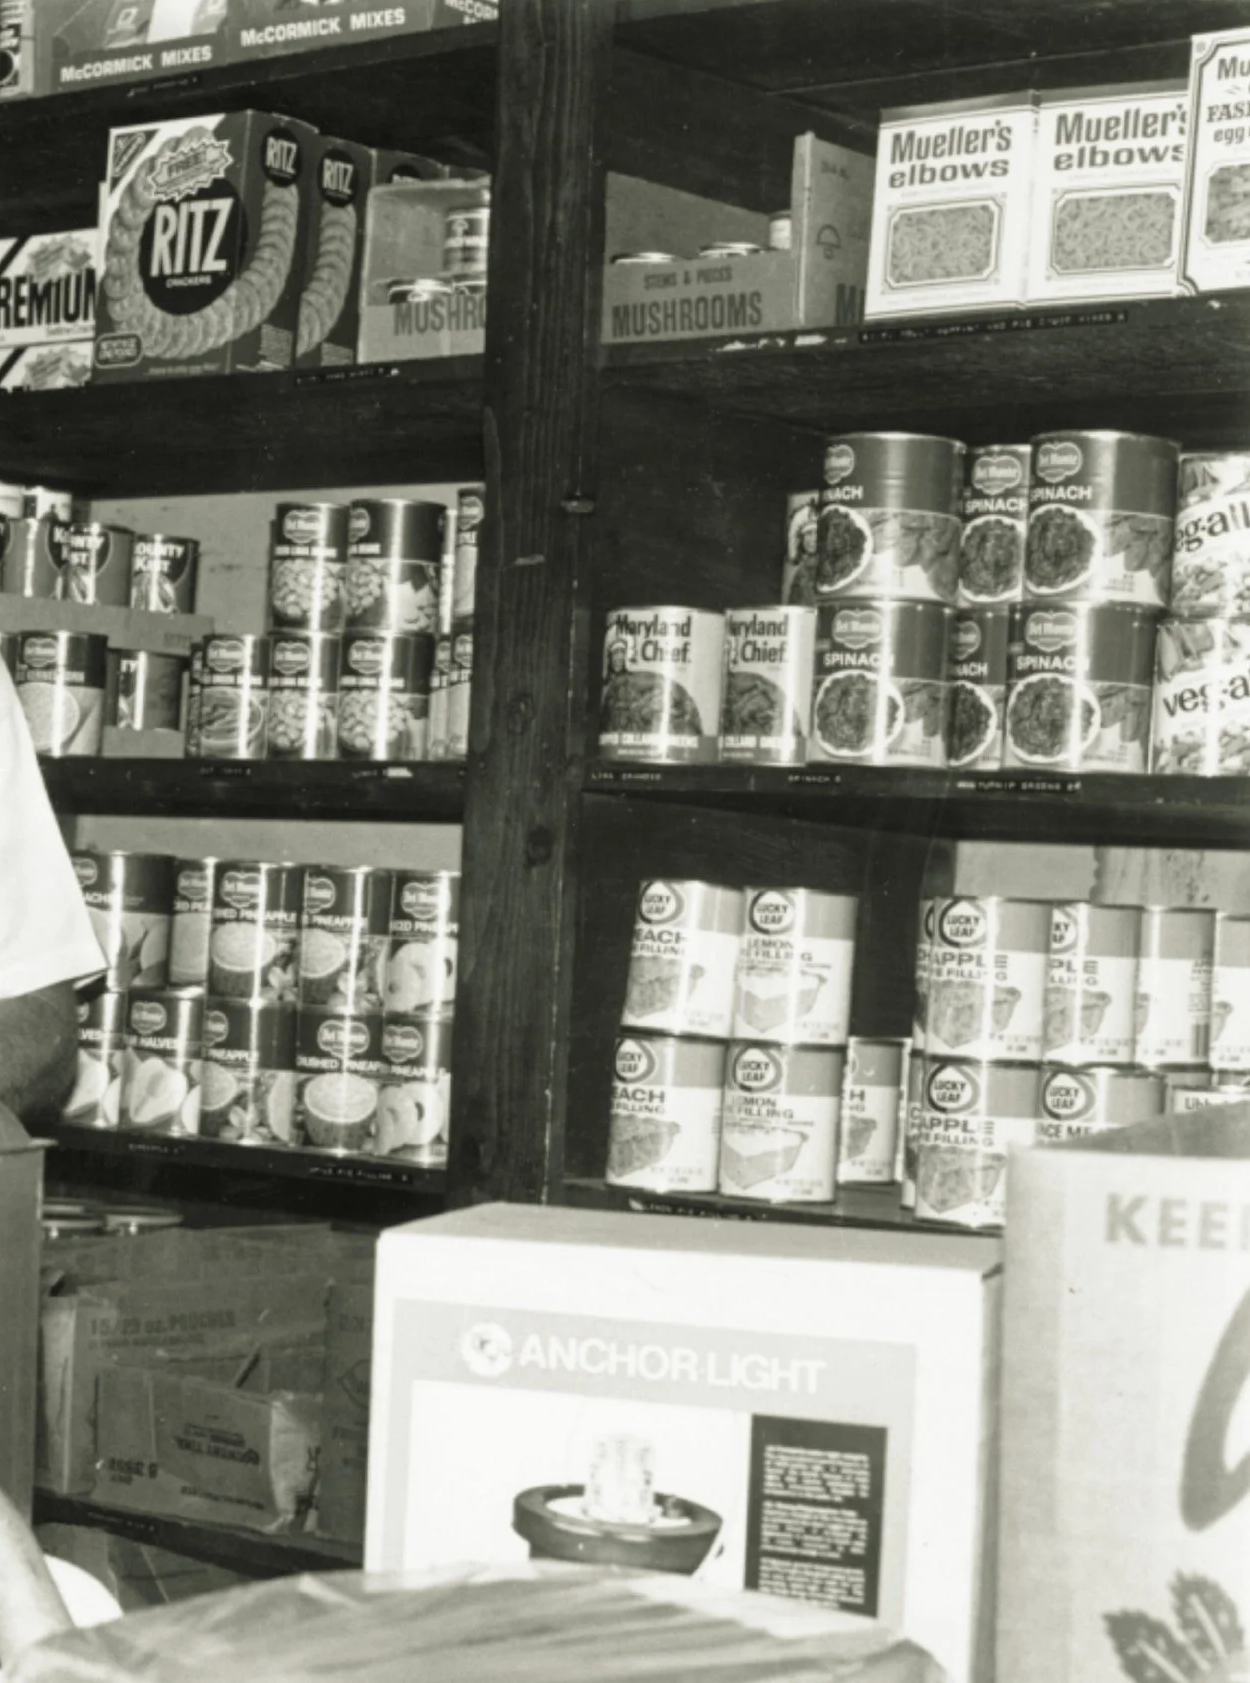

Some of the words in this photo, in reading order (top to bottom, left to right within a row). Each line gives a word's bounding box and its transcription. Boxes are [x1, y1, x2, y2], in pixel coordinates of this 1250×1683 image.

[241, 16, 341, 46] McCORMICK
[350, 7, 406, 31] MIXES
[60, 54, 153, 83] McCORMICK
[161, 45, 212, 67] MIXES
[890, 119, 1012, 165] Mueller's
[1213, 125, 1245, 146] egg
[266, 135, 298, 174] RITZ
[322, 158, 354, 196] RITZ
[888, 158, 1010, 189] elbows
[149, 197, 234, 279] RITZ
[612, 291, 763, 338] MUSHROOMS
[641, 639, 690, 662] Chef
[1016, 655, 1091, 672] SPINAC
[756, 903, 789, 914] LUCKY
[759, 914, 784, 925] LEAF
[946, 914, 981, 926] LUCKY
[949, 926, 975, 938] LEAF
[739, 1059, 770, 1073] LUCKY
[741, 1071, 766, 1083] LEAF
[933, 1080, 967, 1093] LUCKY
[935, 1091, 962, 1103] LEAF
[706, 1350, 828, 1394] LIGHT
